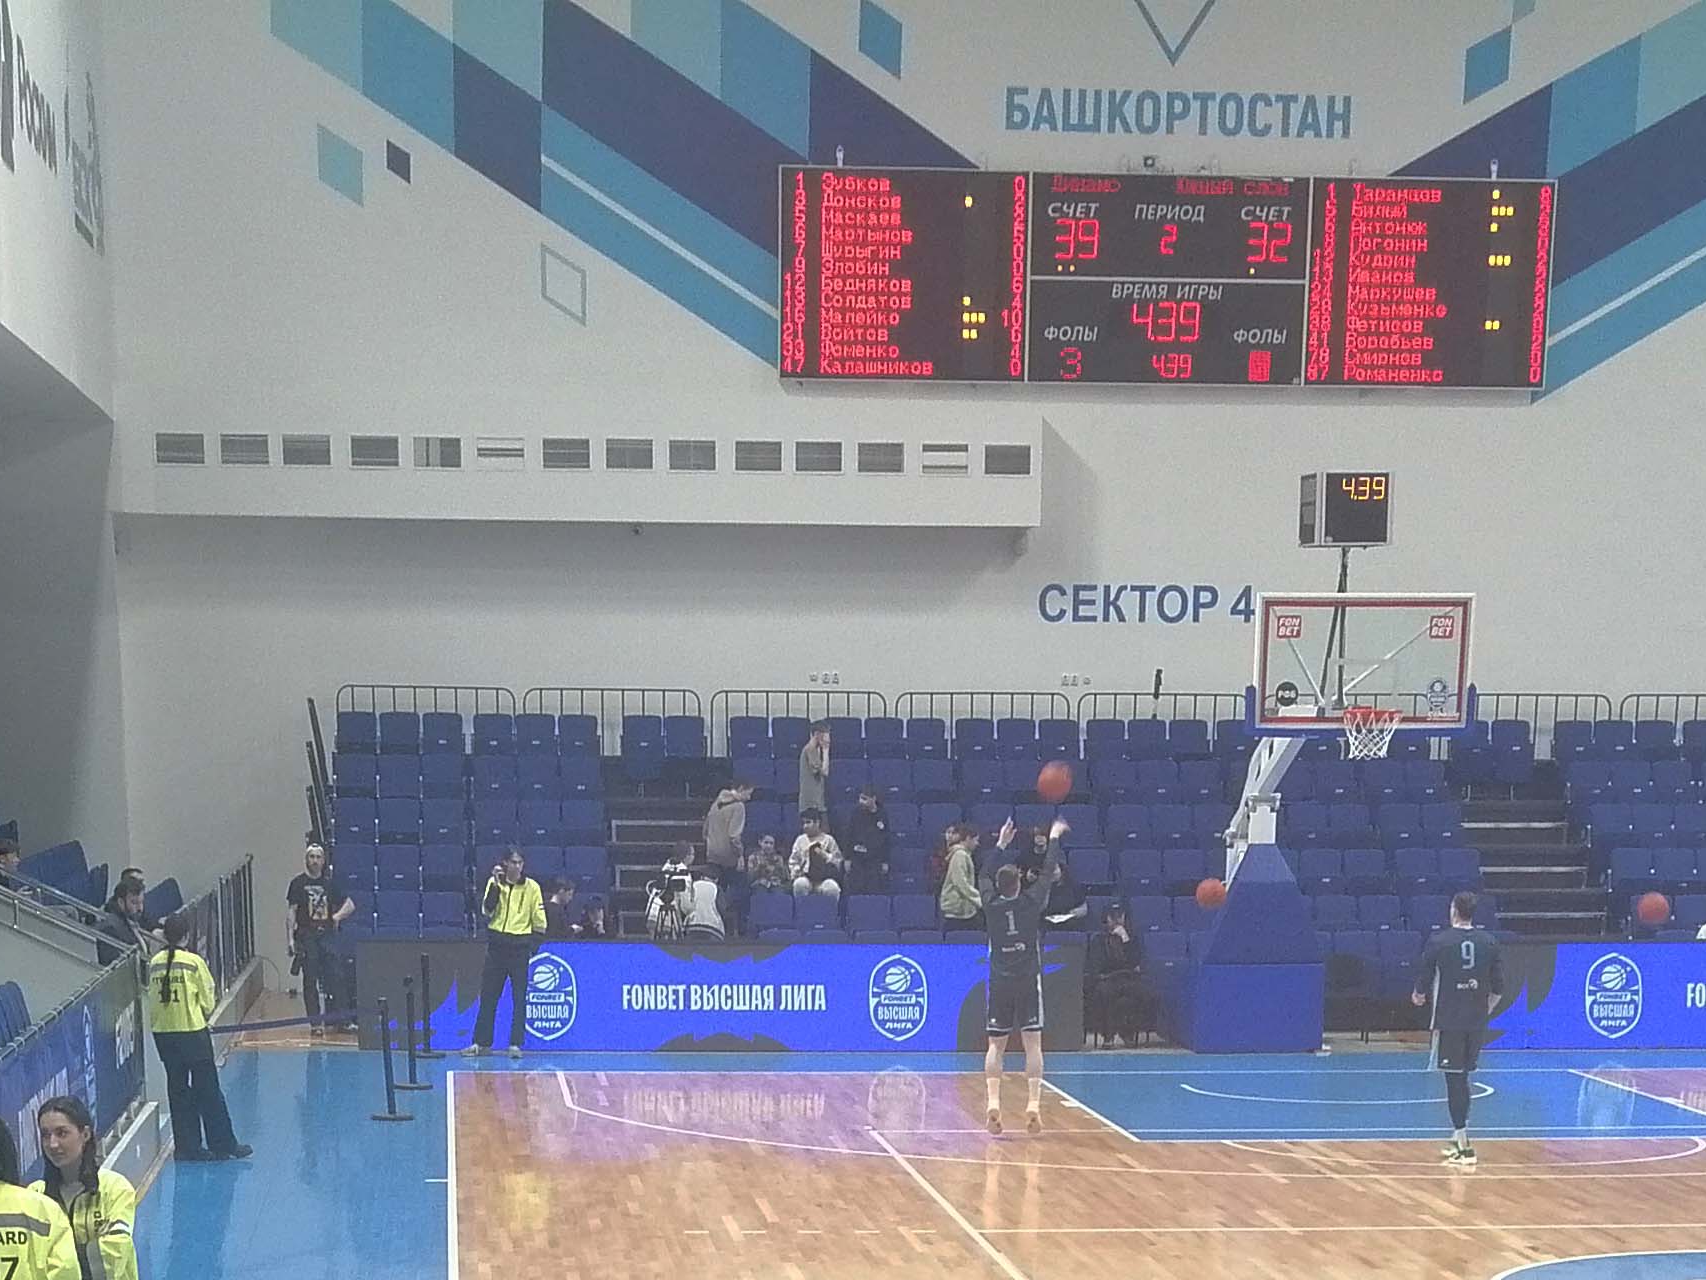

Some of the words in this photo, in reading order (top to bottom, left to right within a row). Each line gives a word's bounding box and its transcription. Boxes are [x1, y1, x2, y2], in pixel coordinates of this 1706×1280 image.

[1004, 86, 1353, 139] БАШКОРТОСТАН
[1048, 202, 1099, 217] СЧЕТ
[1134, 204, 1205, 222] ПЕРИОД
[1241, 206, 1292, 221] СЧЕТ
[1054, 219, 1099, 259] 39
[1160, 224, 1178, 255] 2
[1246, 222, 1292, 262] 32
[822, 257, 890, 275] Злобин
[1112, 283, 1168, 299] ВРЕМЯ
[1177, 284, 1223, 300] ИГРЫ
[1044, 326, 1098, 341] ФОЛЫ
[1233, 329, 1288, 345] ФОЛЫ
[1060, 347, 1082, 379] 3
[1345, 348, 1422, 366] Смирнов
[819, 358, 933, 376] Калашников
[1344, 366, 1444, 383] Романенко
[1039, 583, 1219, 624] СЕКТОР
[1230, 585, 1255, 624] 4
[1278, 616, 1300, 627] FON
[1431, 616, 1454, 627] FON
[1278, 626, 1300, 637] BET
[1431, 626, 1453, 637] BET
[1004, 910, 1018, 936] 1
[1461, 940, 1475, 969] 9
[622, 984, 687, 1011] FONBET
[690, 984, 773, 1011] ВЫСШАЯ
[779, 984, 827, 1011] ЛИГА
[526, 1004, 569, 1019] ВЫСШАЯ
[878, 1006, 920, 1020] ВЫСШАЯ
